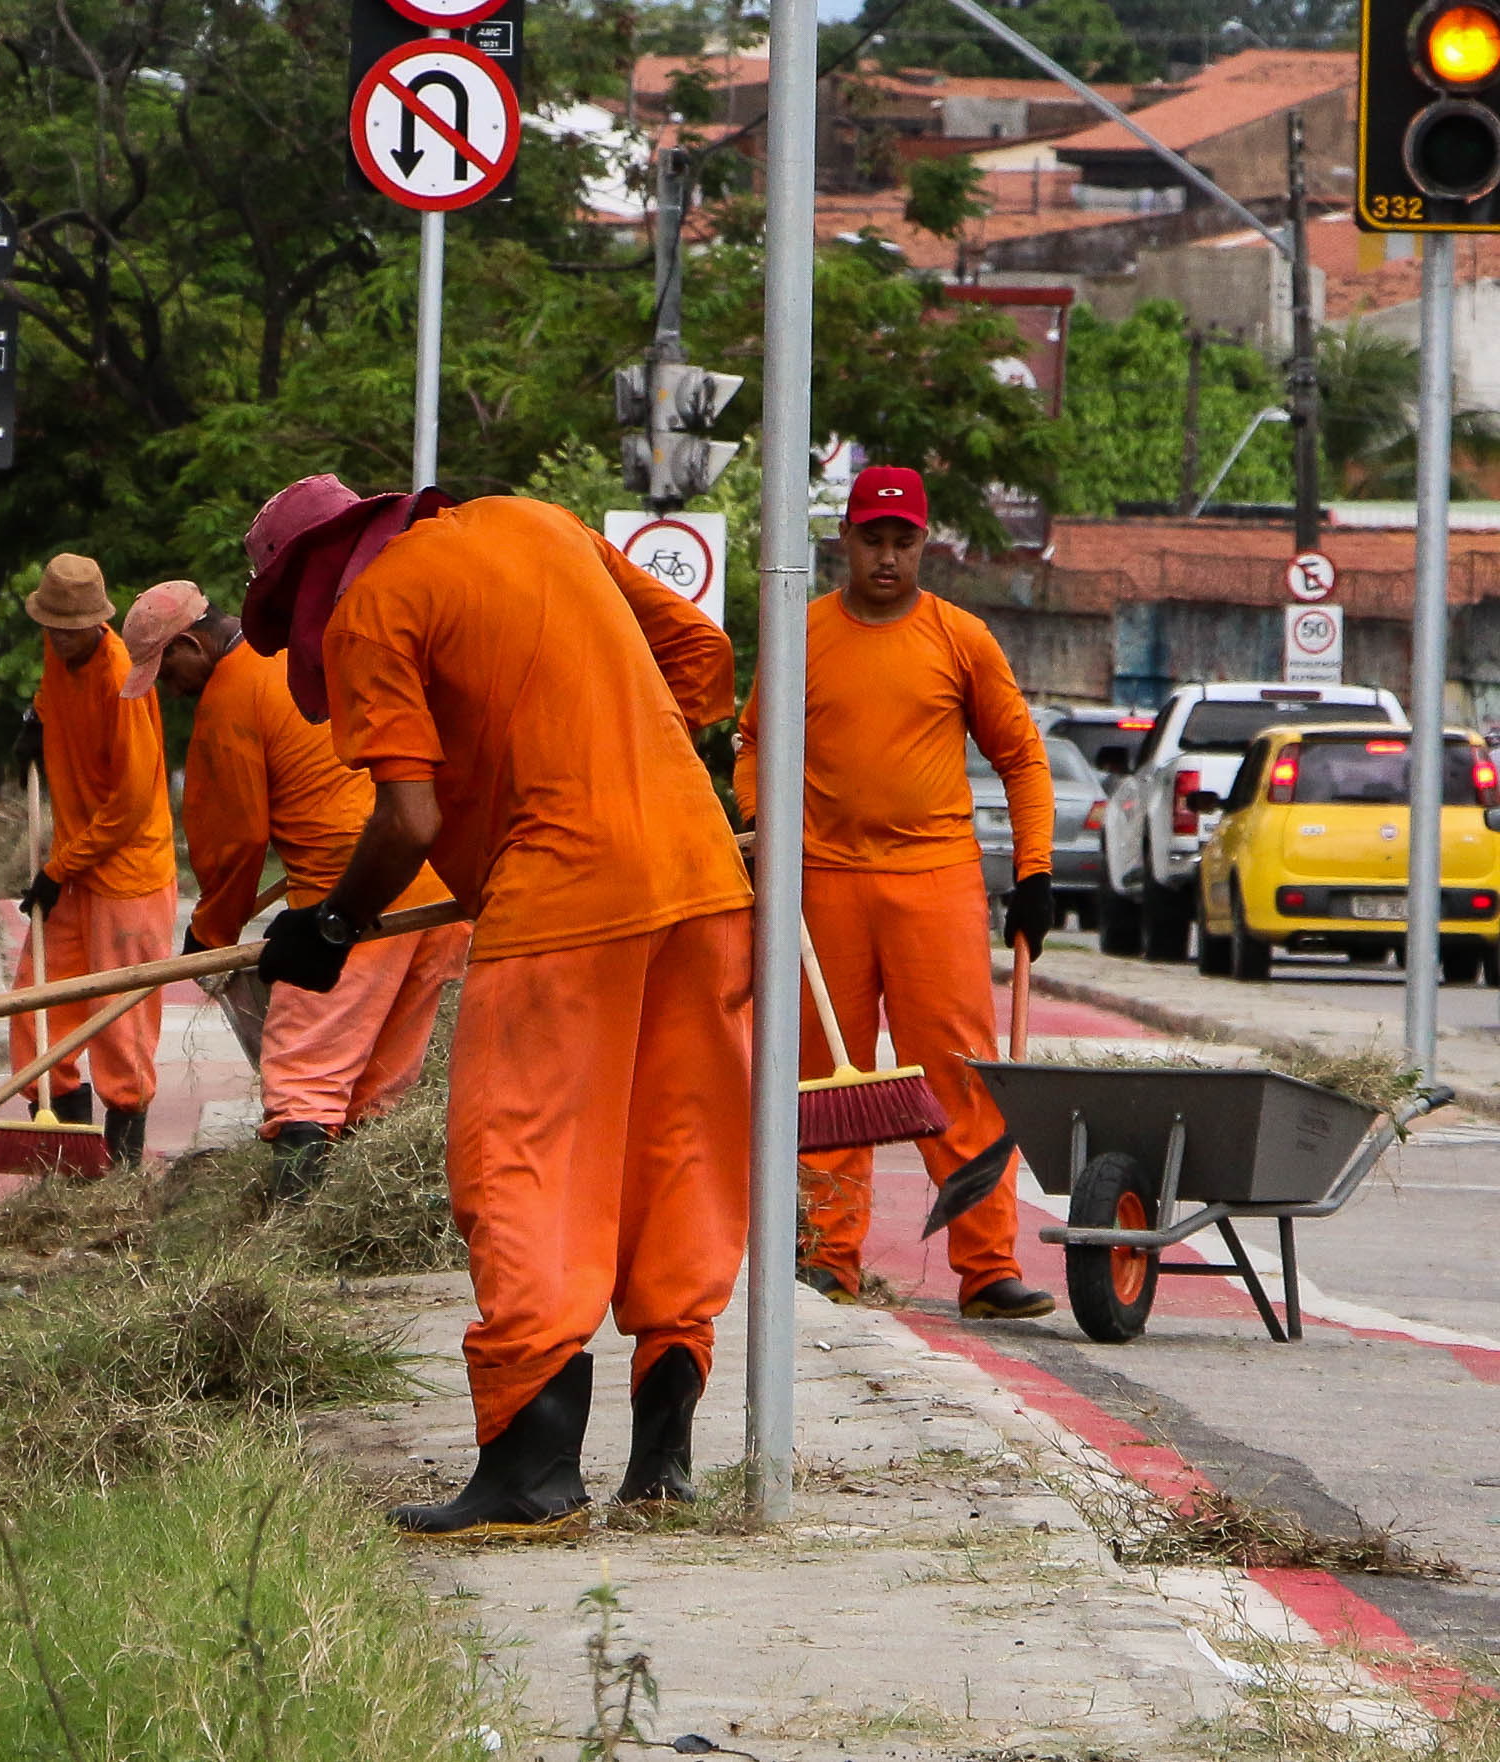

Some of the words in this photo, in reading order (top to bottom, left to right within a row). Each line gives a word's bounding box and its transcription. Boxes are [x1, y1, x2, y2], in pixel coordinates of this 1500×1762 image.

[476, 27, 502, 36] AMC
[1372, 194, 1424, 219] 332
[1302, 621, 1328, 638] 50
